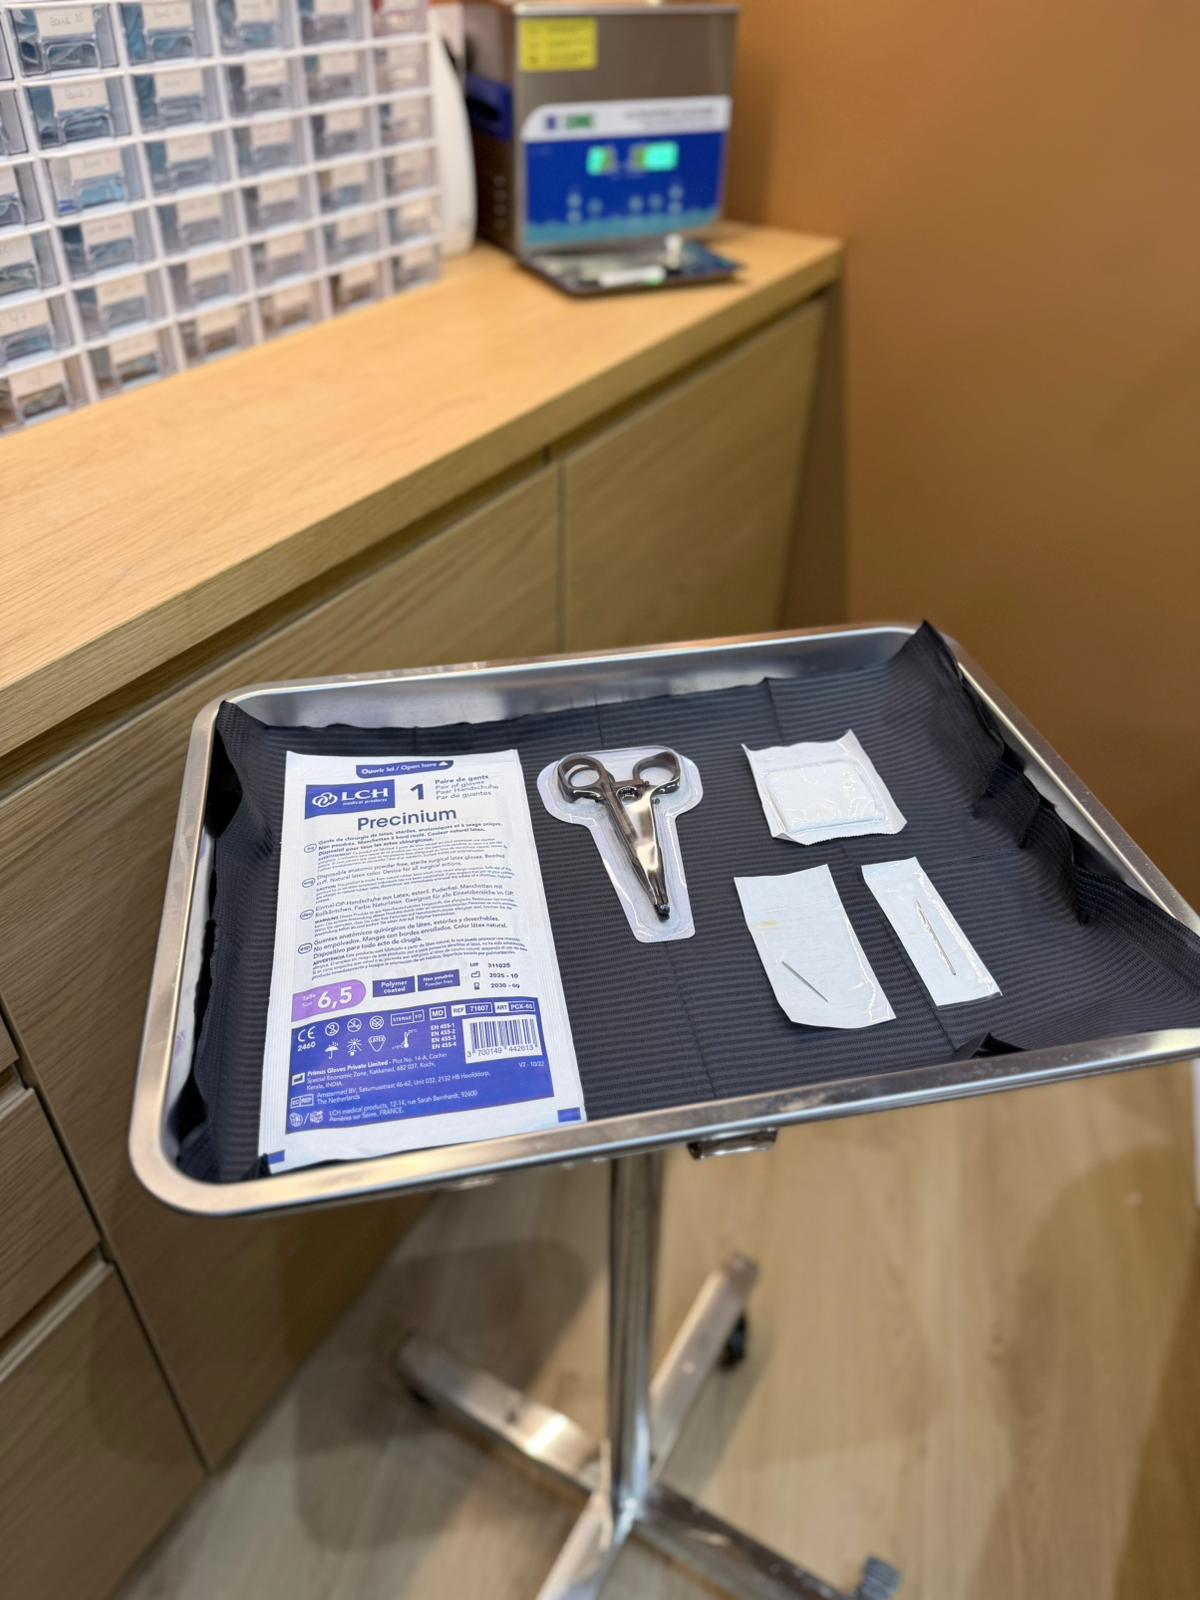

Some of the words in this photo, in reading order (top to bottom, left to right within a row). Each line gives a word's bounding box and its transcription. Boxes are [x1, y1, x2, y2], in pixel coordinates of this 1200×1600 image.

[361, 766, 384, 775] Ouvrir
[401, 764, 420, 772] Open
[468, 774, 489, 782] gants
[454, 784, 500, 793] Handschuhe
[461, 780, 484, 788] gloves
[341, 788, 389, 802] LCH
[410, 784, 424, 800] 1
[462, 790, 492, 799] guantes
[358, 810, 456, 832] Precinium
[314, 936, 338, 946] Guantes
[362, 934, 386, 944] Mangas
[313, 948, 346, 960] Dispositivo
[346, 946, 361, 954] para
[380, 980, 408, 990] Polymer
[384, 986, 406, 994] coated
[318, 984, 353, 1008] 6,5
[431, 1008, 444, 1017] MD
[298, 1040, 316, 1052] 2460
[478, 1048, 503, 1056] 700149
[307, 1070, 326, 1078] Primus
[327, 1066, 346, 1074] Gloves
[348, 1062, 367, 1071] Private
[368, 1060, 389, 1068] Limited
[326, 1074, 352, 1082] Economic
[328, 1094, 360, 1104] Netherlands
[342, 1106, 362, 1114] medical
